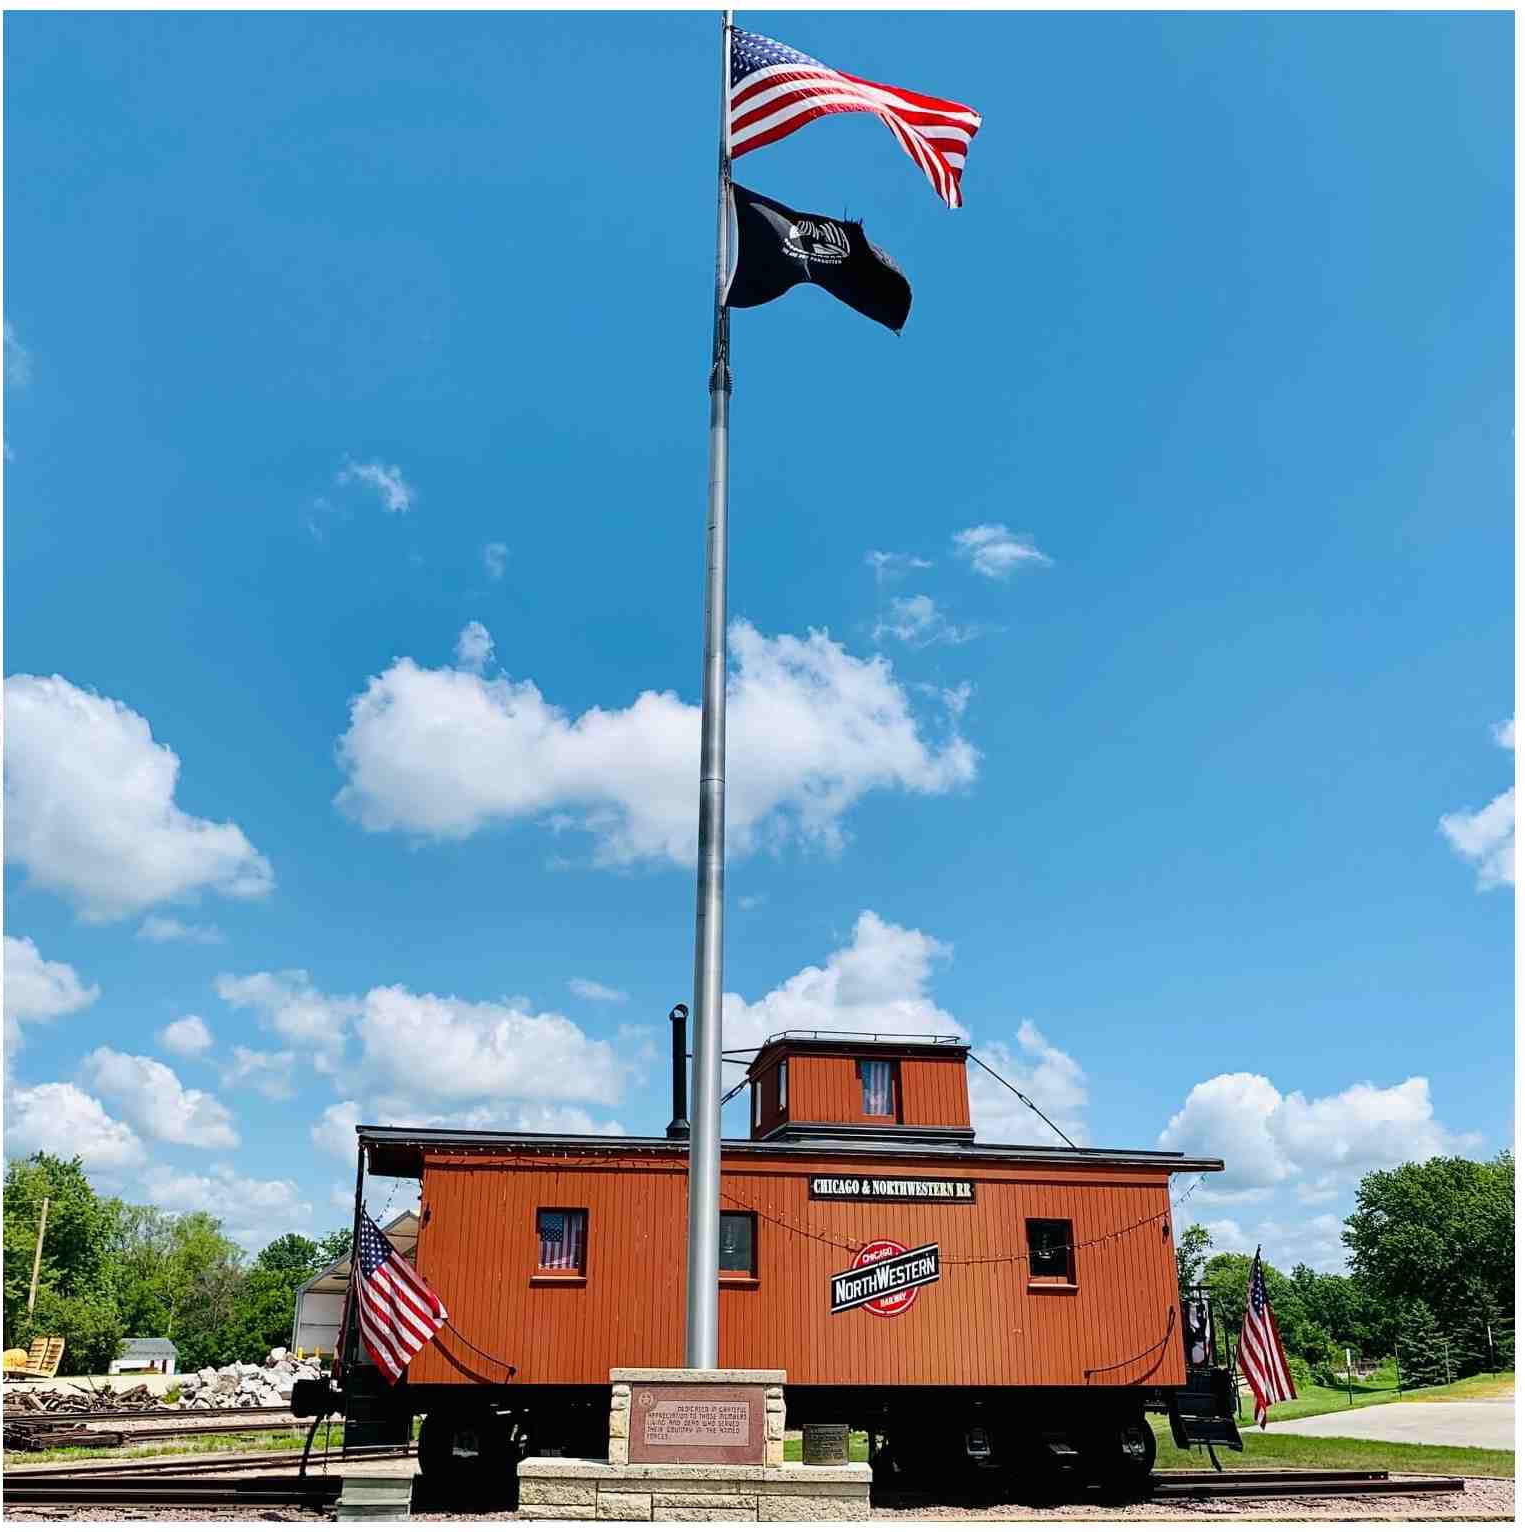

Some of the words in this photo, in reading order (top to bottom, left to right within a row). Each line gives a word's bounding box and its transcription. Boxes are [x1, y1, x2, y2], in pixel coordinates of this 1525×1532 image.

[813, 1178, 859, 1194] CHICAGO
[861, 1180, 871, 1195] &
[872, 1180, 954, 1197] NORTHWESTERN
[956, 1182, 972, 1198] RR
[862, 1246, 893, 1264] CHICAGO
[880, 1291, 907, 1308] RAILWAY
